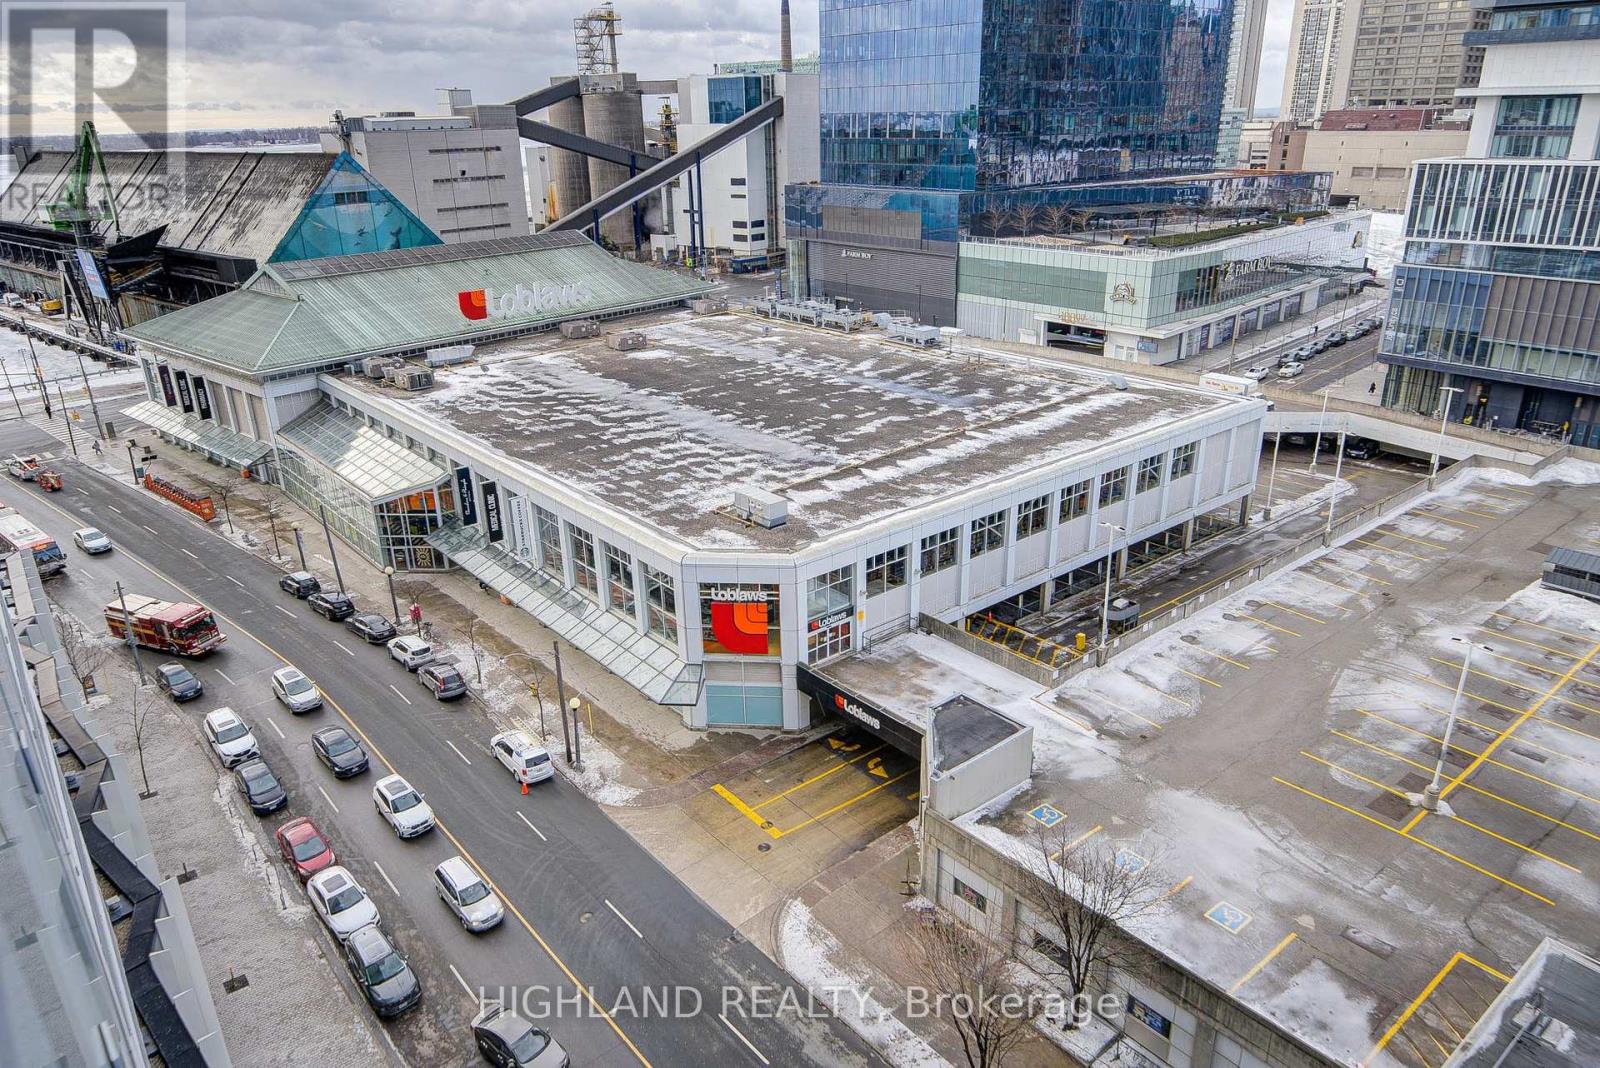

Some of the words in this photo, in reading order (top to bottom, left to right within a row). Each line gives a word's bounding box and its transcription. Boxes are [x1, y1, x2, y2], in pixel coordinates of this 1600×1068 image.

[1235, 259, 1257, 276] FARM
[485, 279, 593, 317] Loblaws
[487, 494, 496, 509] CLINIC
[489, 509, 499, 531] MEDICAL
[710, 587, 768, 602] Loblaws
[818, 612, 847, 628] Loblaws
[843, 698, 880, 730] Loblaws
